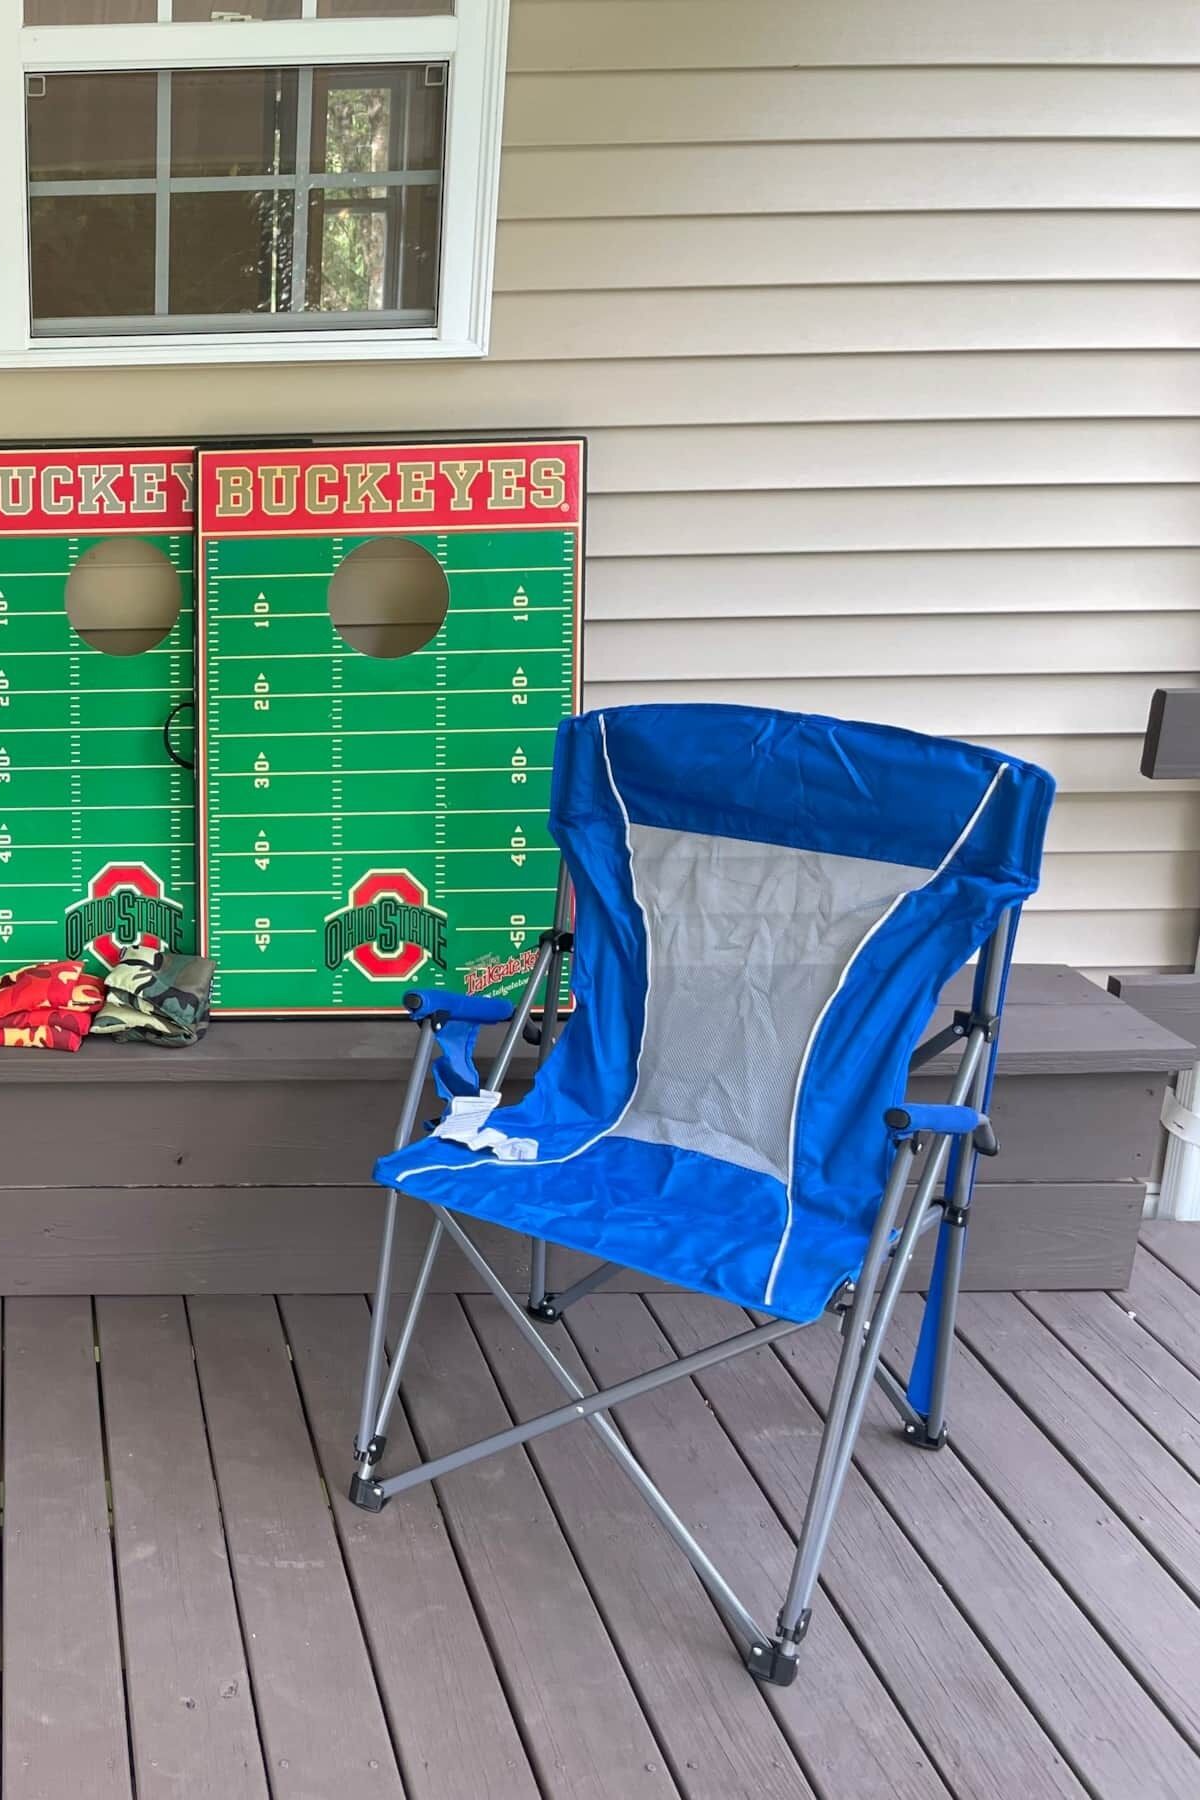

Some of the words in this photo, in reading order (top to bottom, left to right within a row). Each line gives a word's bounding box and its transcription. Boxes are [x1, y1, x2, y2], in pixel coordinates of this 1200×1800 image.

[215, 458, 566, 517] BUCKEYES
[254, 602, 269, 628] 10
[513, 595, 529, 622] 10
[254, 682, 269, 711] 20
[512, 676, 528, 705] 20
[254, 761, 270, 789] 30
[511, 755, 527, 784] 30
[255, 841, 270, 871] 40
[510, 836, 526, 867] 40
[255, 918, 270, 945] 50
[510, 914, 526, 942] 50
